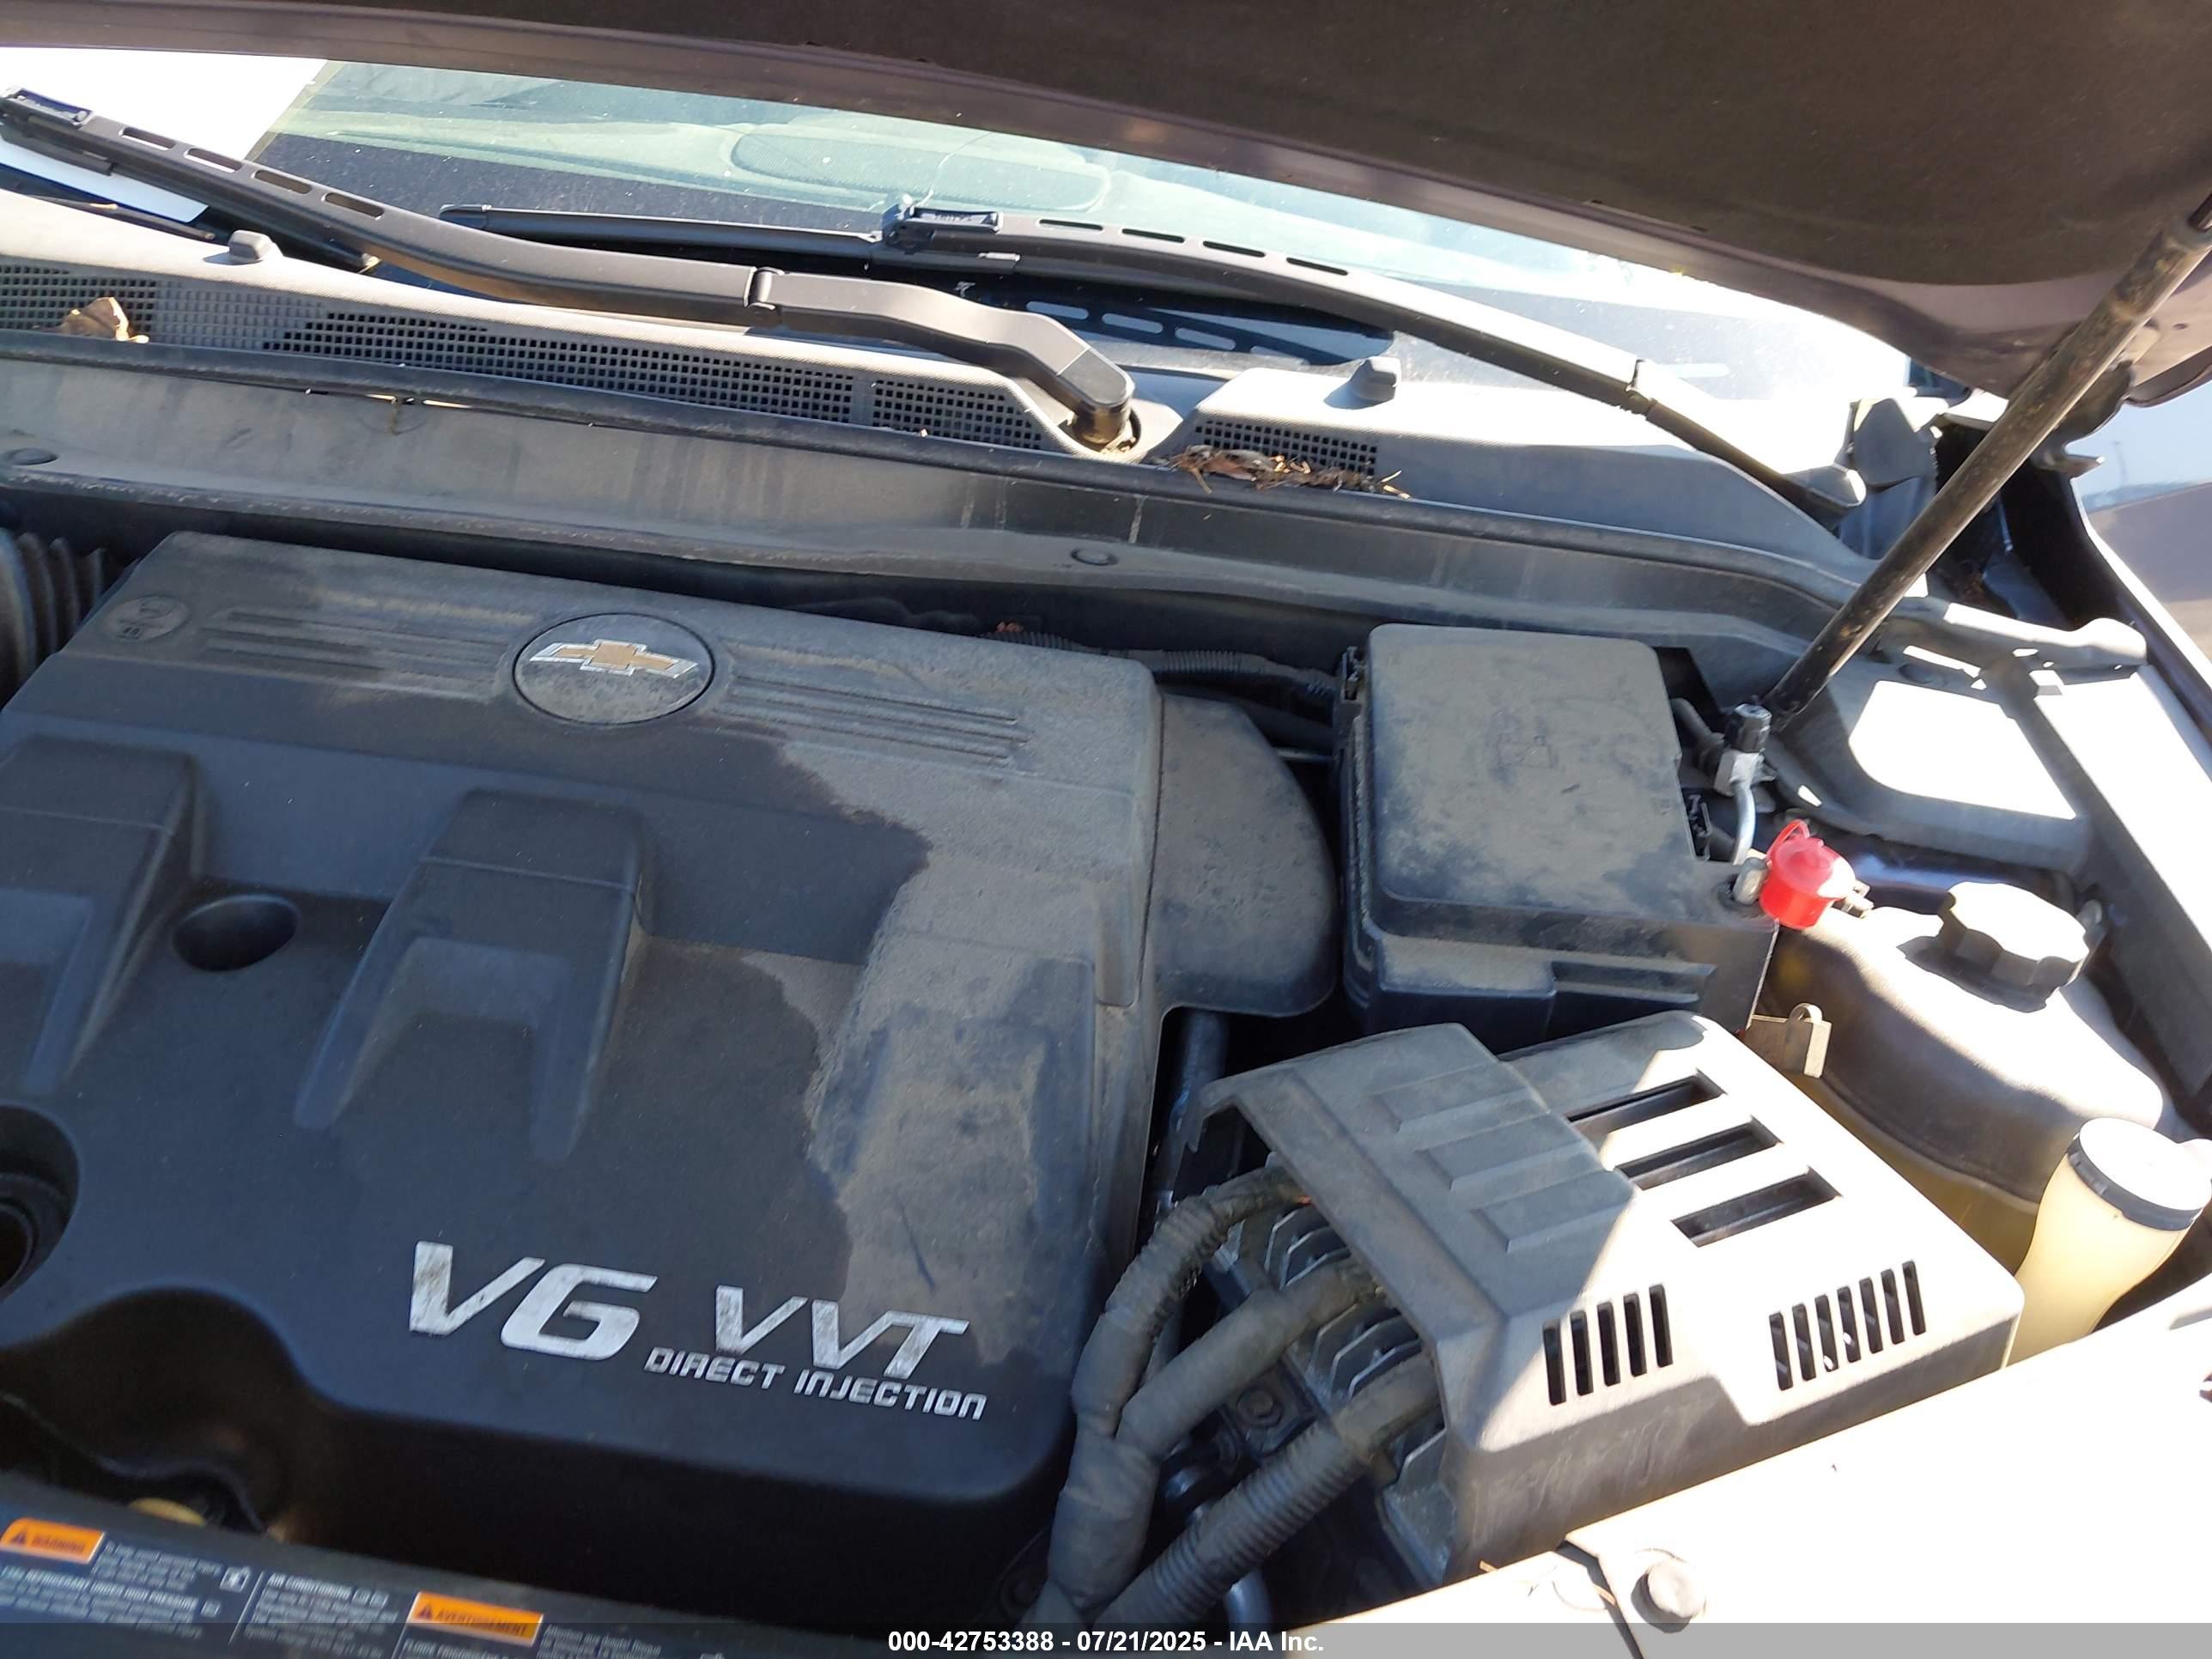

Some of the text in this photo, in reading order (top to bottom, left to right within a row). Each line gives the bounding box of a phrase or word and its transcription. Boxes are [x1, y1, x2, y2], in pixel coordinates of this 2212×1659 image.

[409, 1240, 969, 1379] V6 VVT
[644, 1346, 989, 1422] DIRECT INJECTION
